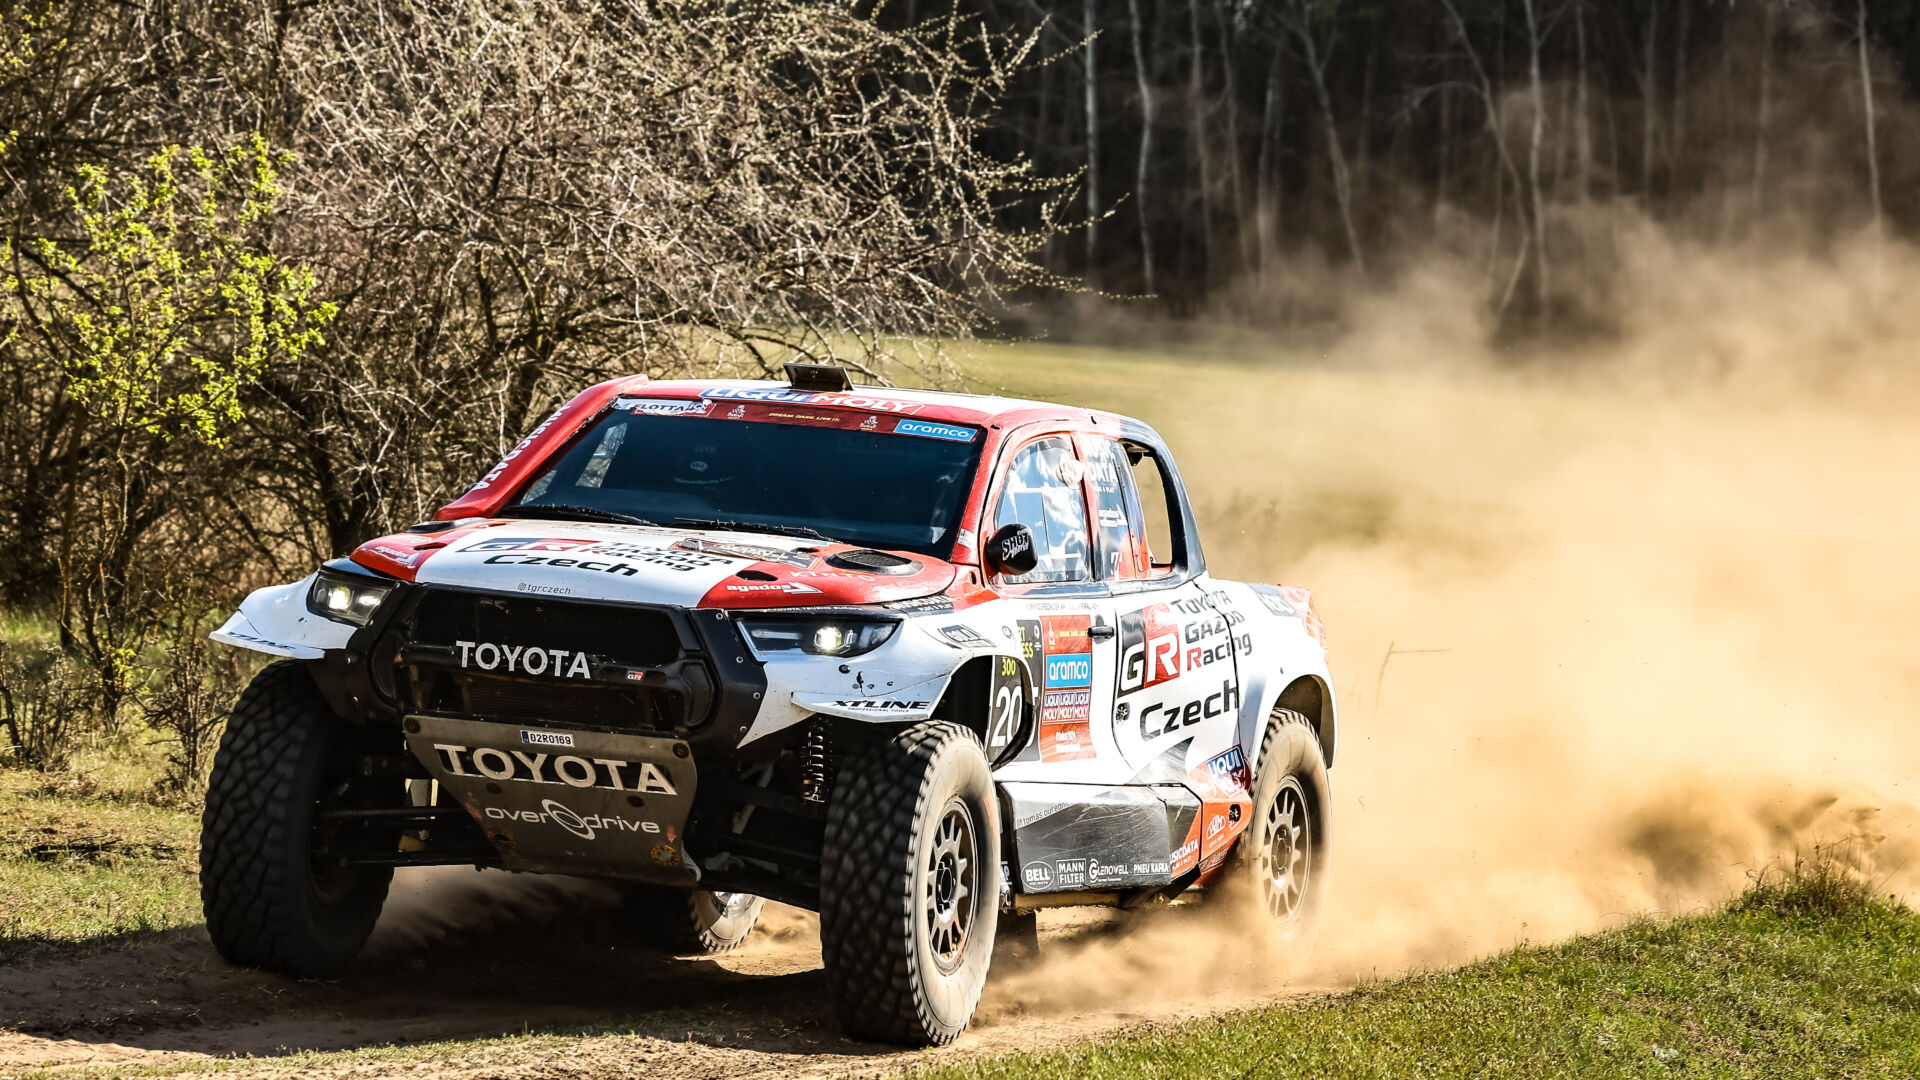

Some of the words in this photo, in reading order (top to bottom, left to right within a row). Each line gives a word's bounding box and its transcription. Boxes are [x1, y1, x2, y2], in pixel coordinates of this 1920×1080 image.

[701, 387, 808, 402] LIQUI
[810, 395, 921, 413] MOLY
[901, 423, 969, 438] aramco
[483, 554, 640, 577] Czech
[578, 548, 697, 572] Racing
[517, 582, 571, 595] @tgrczech
[726, 583, 792, 593] agados
[1170, 589, 1233, 615] TOYOTA
[1184, 610, 1246, 645] GAZOO
[455, 640, 591, 679] TOYOTA
[1120, 632, 1179, 692] GR
[1186, 632, 1253, 672] Racing
[627, 673, 643, 681] GR
[1049, 661, 1089, 681] aramco
[832, 699, 930, 710] XTLINE
[1139, 679, 1240, 742] Czech
[433, 743, 678, 796] TOYOTA
[1207, 750, 1241, 778] LIQUI
[1025, 868, 1051, 881] BELL
[1058, 861, 1085, 872] MANN
[1133, 864, 1150, 874] PNEU
[1059, 873, 1085, 884] FILTER
